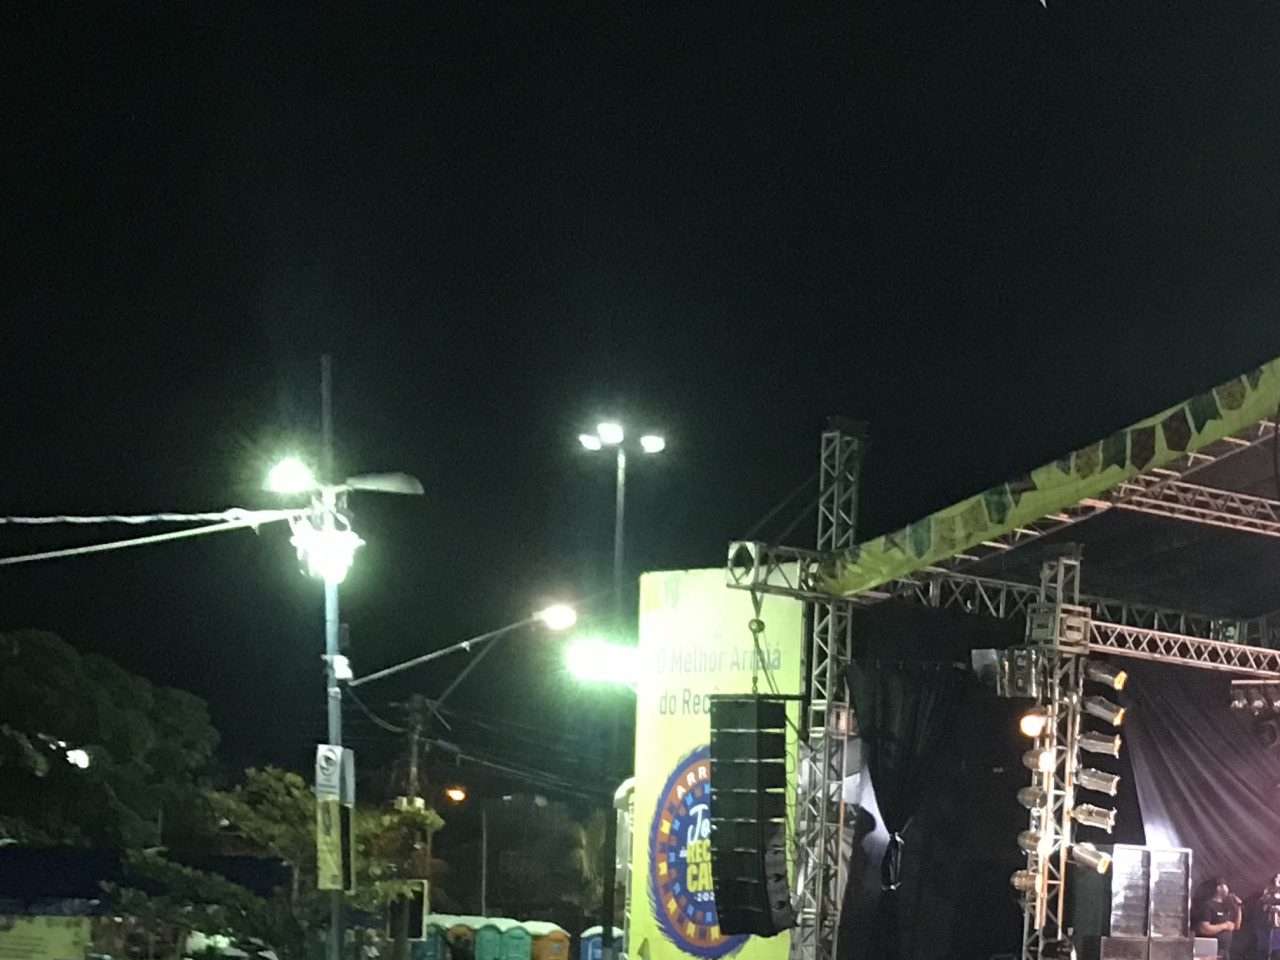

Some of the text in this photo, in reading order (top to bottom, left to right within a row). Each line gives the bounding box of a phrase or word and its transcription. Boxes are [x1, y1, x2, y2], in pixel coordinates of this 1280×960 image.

[671, 645, 724, 673] Melhor
[660, 686, 719, 715] do Rec
